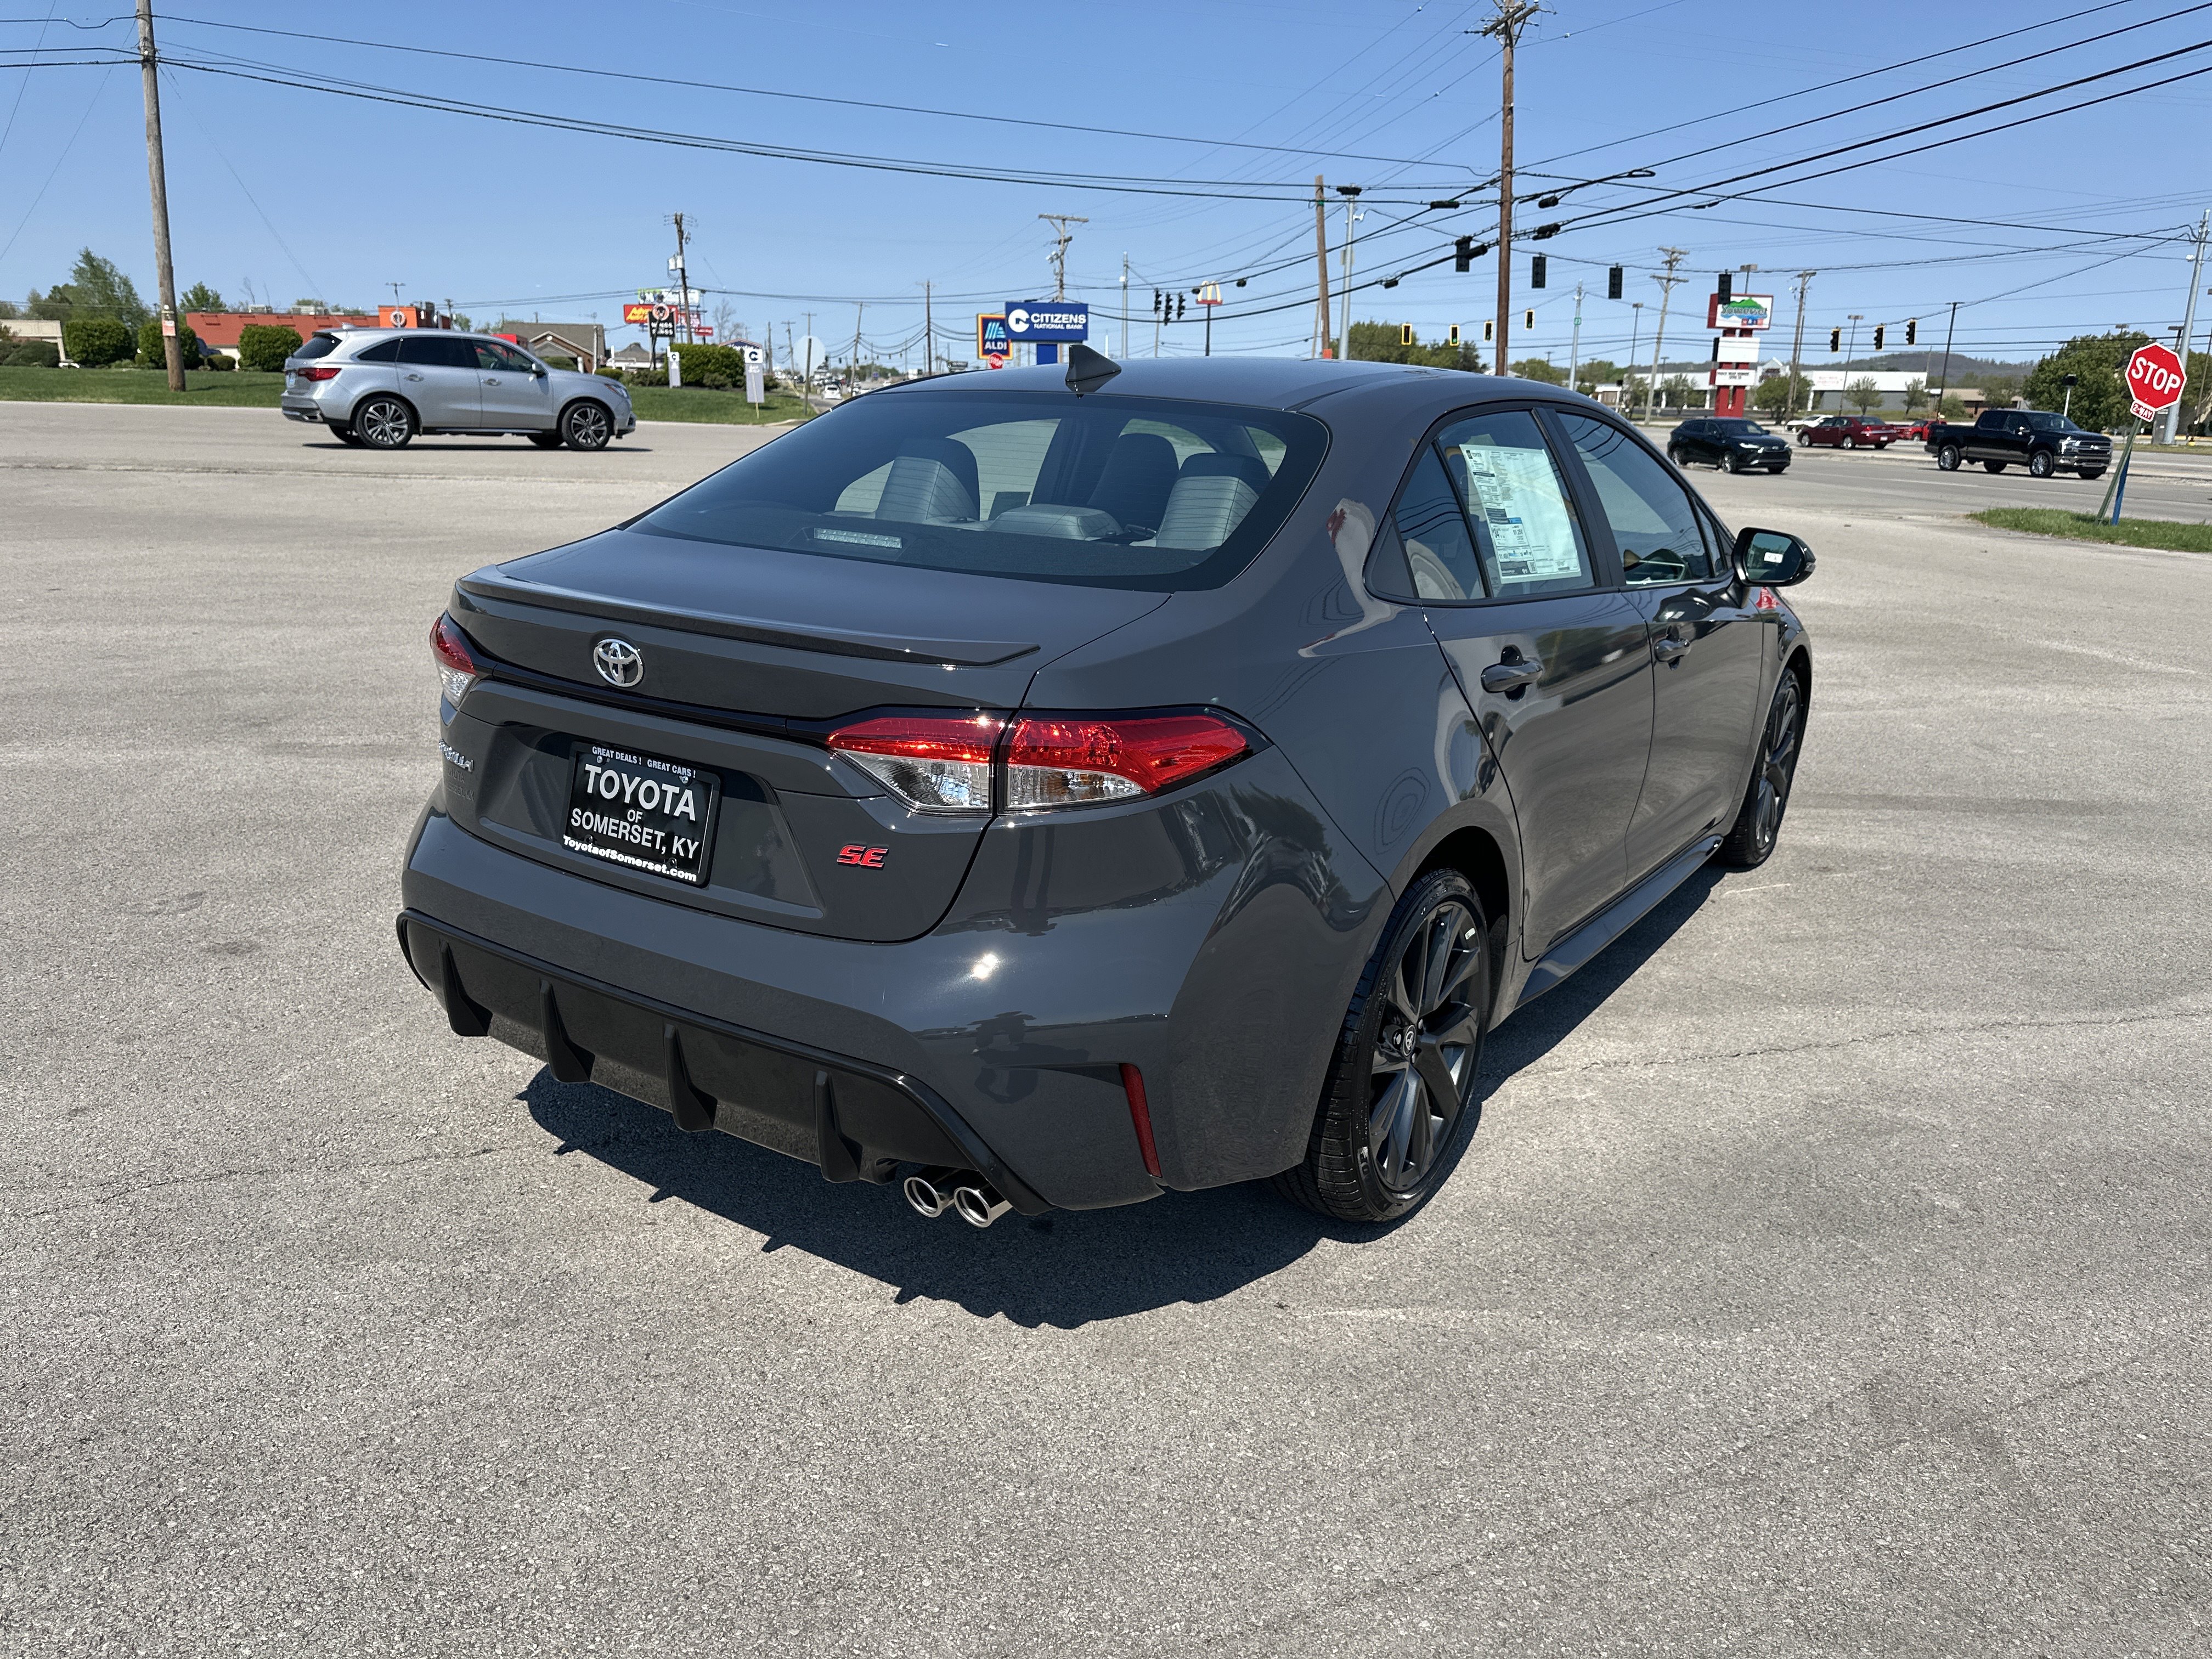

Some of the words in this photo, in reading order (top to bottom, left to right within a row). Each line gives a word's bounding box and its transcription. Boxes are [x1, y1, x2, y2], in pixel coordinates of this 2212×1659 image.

[1030, 313, 1087, 324] CITIZENS
[984, 341, 1007, 350] ALDI
[2131, 356, 2181, 395] STOP
[2132, 403, 2153, 420] 2-WAY
[592, 746, 614, 759] GREAT
[647, 759, 670, 772] GREAT
[585, 764, 696, 821] TOYOTA
[627, 809, 643, 823] OF
[571, 808, 666, 855] SOMERSET,
[672, 836, 699, 859] KY
[563, 834, 697, 882] ToyotaofSomerset.com
[837, 845, 889, 867] SE
